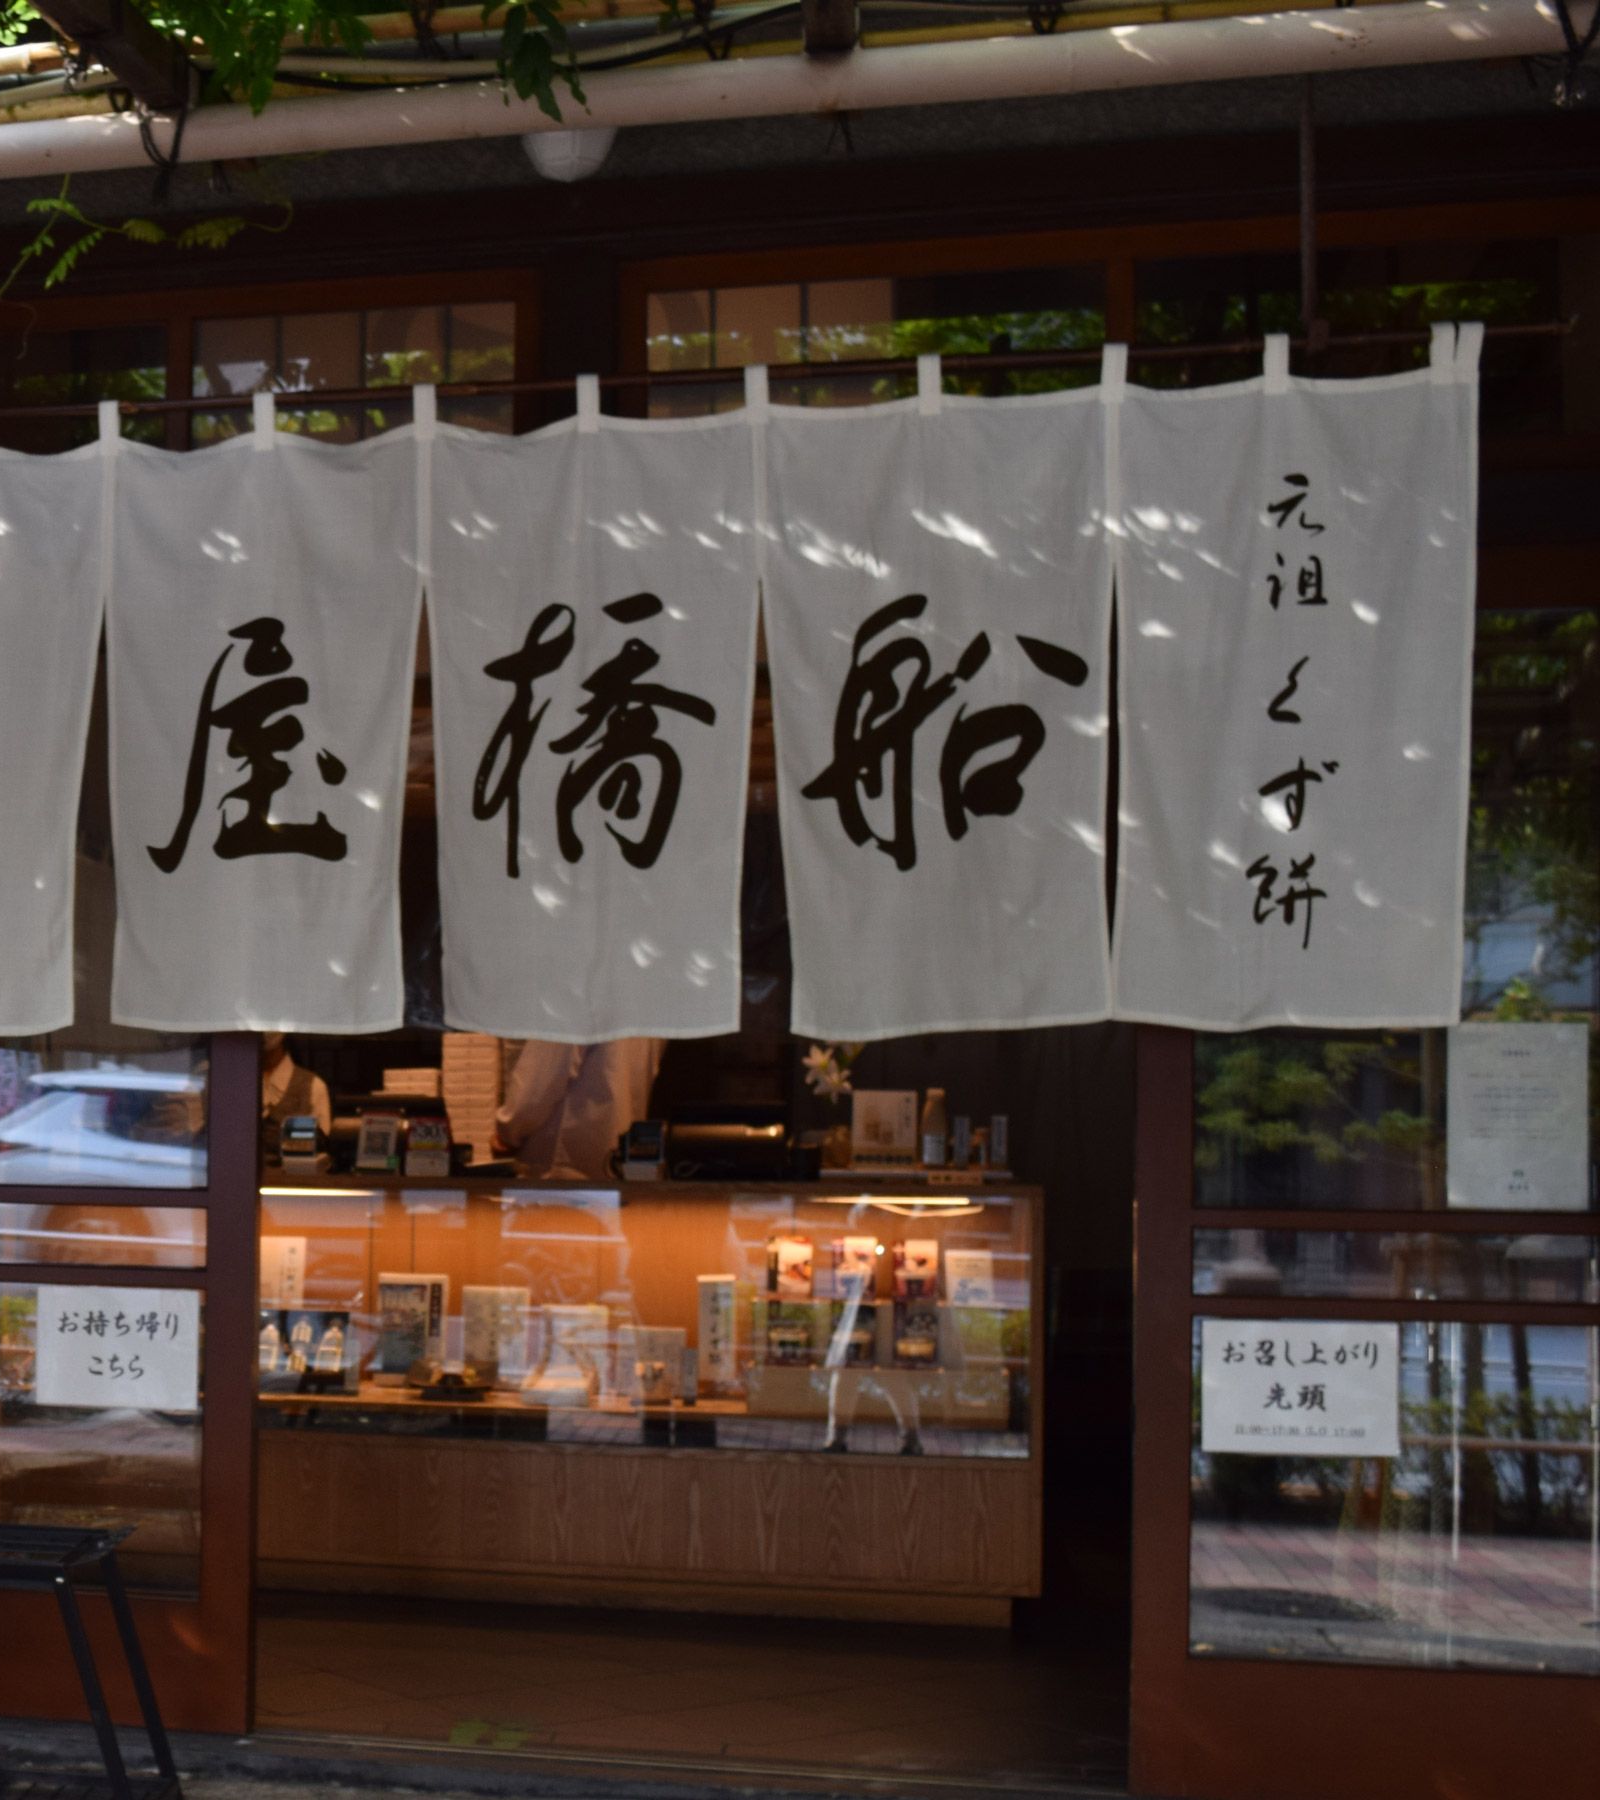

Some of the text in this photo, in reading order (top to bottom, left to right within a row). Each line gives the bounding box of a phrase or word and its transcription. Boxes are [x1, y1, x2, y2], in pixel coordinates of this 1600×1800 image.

[1245, 473, 1340, 950] 元祖くず餅
[57, 1310, 179, 1341] お持ち帰り
[88, 1353, 145, 1380] こちら
[1222, 1340, 1379, 1368] お召し上がり
[1264, 1382, 1327, 1412] 先頭
